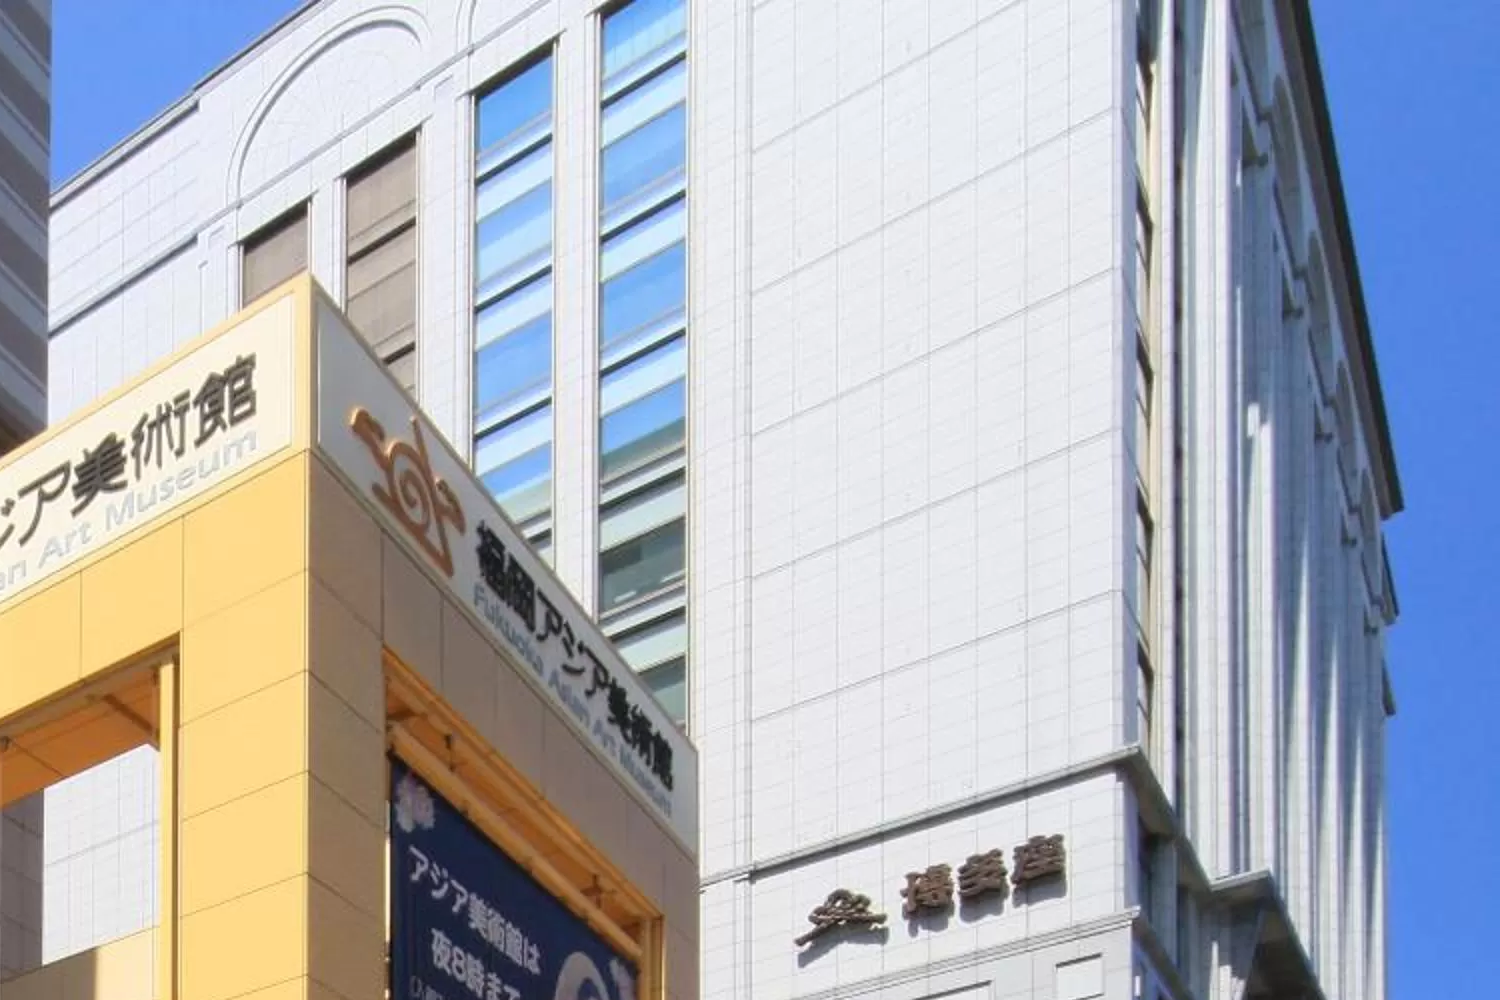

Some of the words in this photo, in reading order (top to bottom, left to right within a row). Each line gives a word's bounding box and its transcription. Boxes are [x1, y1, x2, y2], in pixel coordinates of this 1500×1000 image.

[37, 518, 93, 567] Art
[104, 430, 257, 526] Museum
[475, 519, 673, 792] 福岡アジア美術館
[408, 845, 541, 976] アジア美術館は
